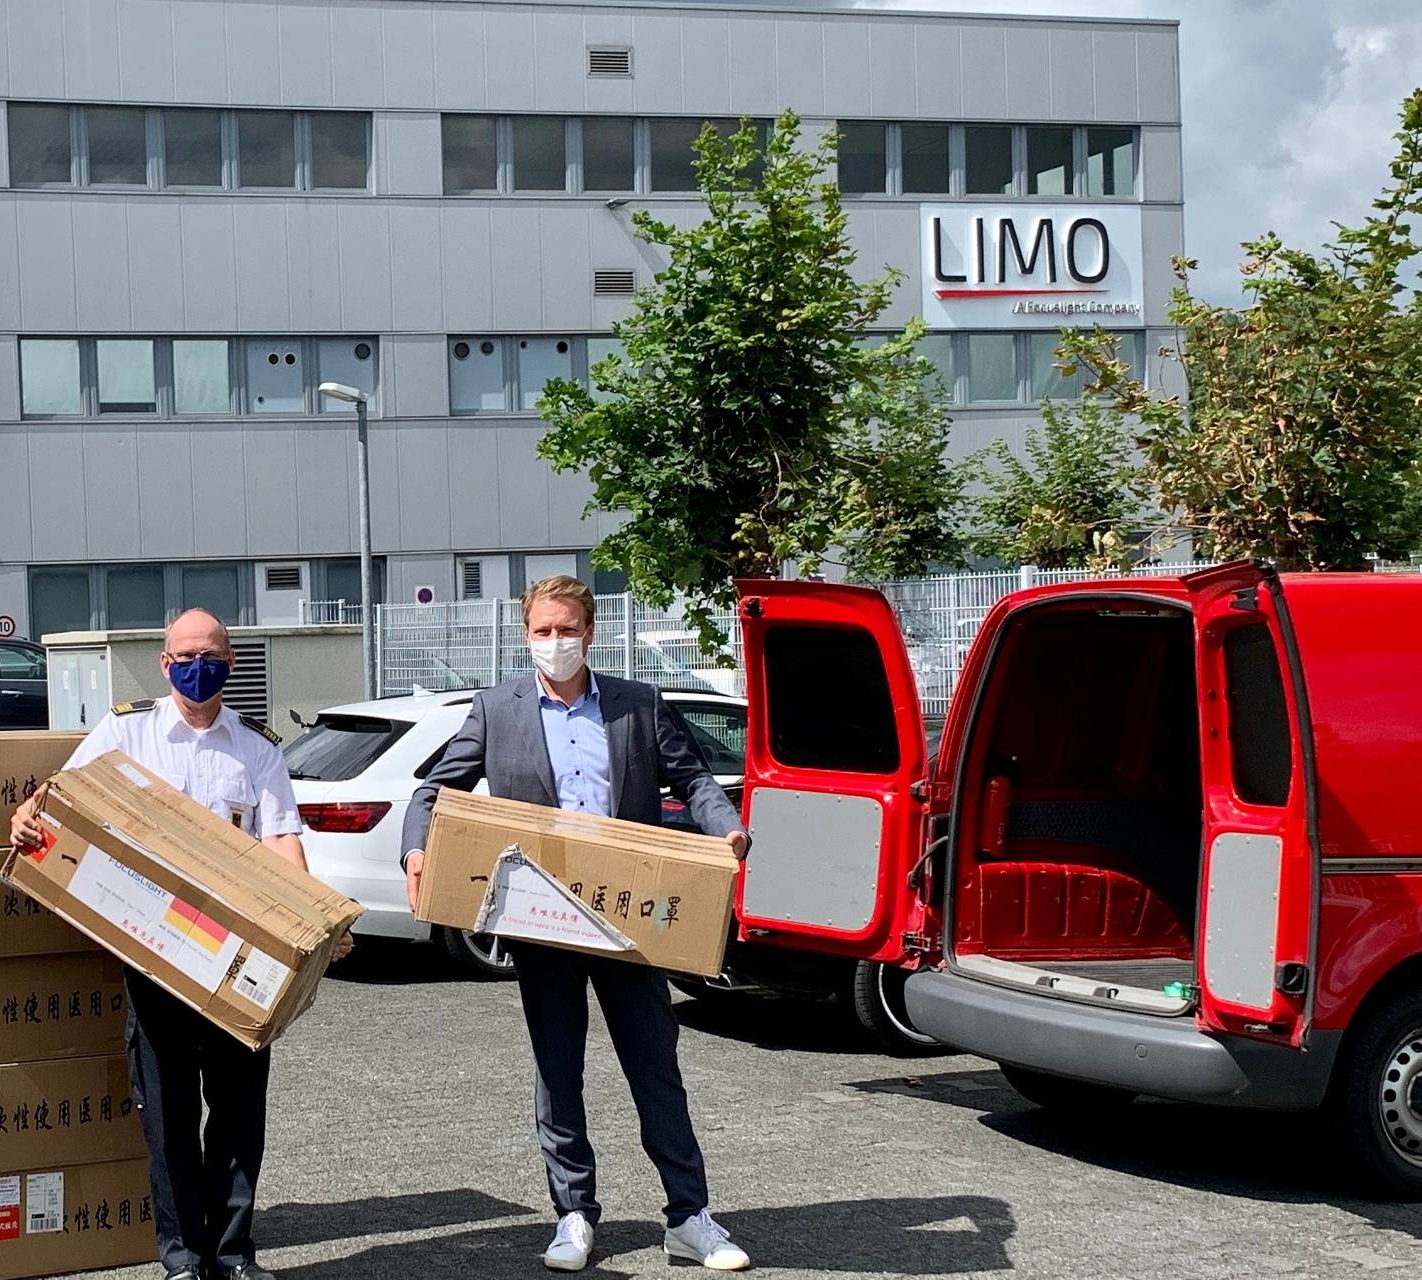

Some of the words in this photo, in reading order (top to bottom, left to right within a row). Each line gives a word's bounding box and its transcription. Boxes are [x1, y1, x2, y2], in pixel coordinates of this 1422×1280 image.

[933, 217, 1110, 284] LIMO
[1025, 301, 1087, 315] Focuslight
[1087, 301, 1140, 315] Company
